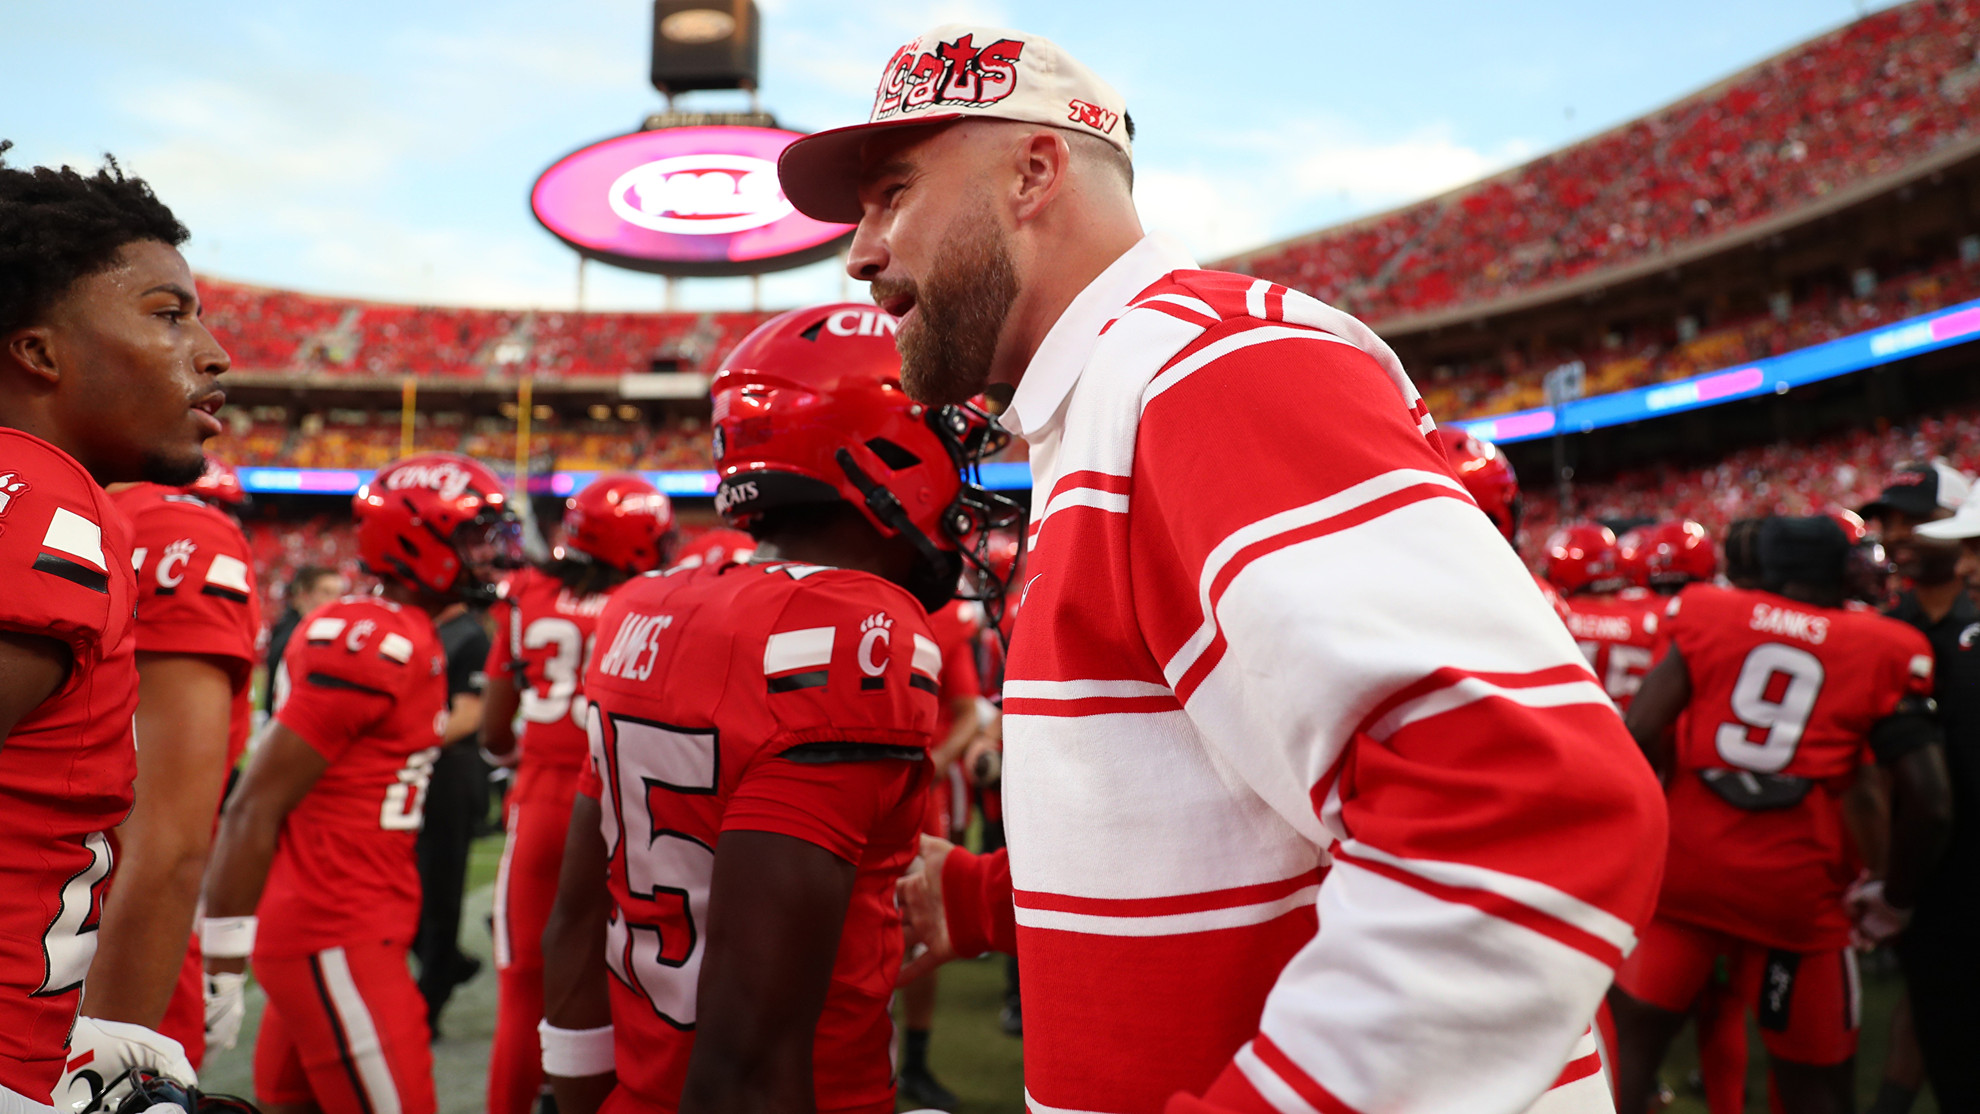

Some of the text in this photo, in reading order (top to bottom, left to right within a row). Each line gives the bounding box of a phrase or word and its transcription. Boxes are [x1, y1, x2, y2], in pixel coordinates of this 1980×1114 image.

[826, 310, 904, 338] CIN
[600, 610, 674, 682] JAMES
[1749, 602, 1831, 645] SANKS
[519, 616, 596, 732] 3
[1715, 641, 1825, 773] 9
